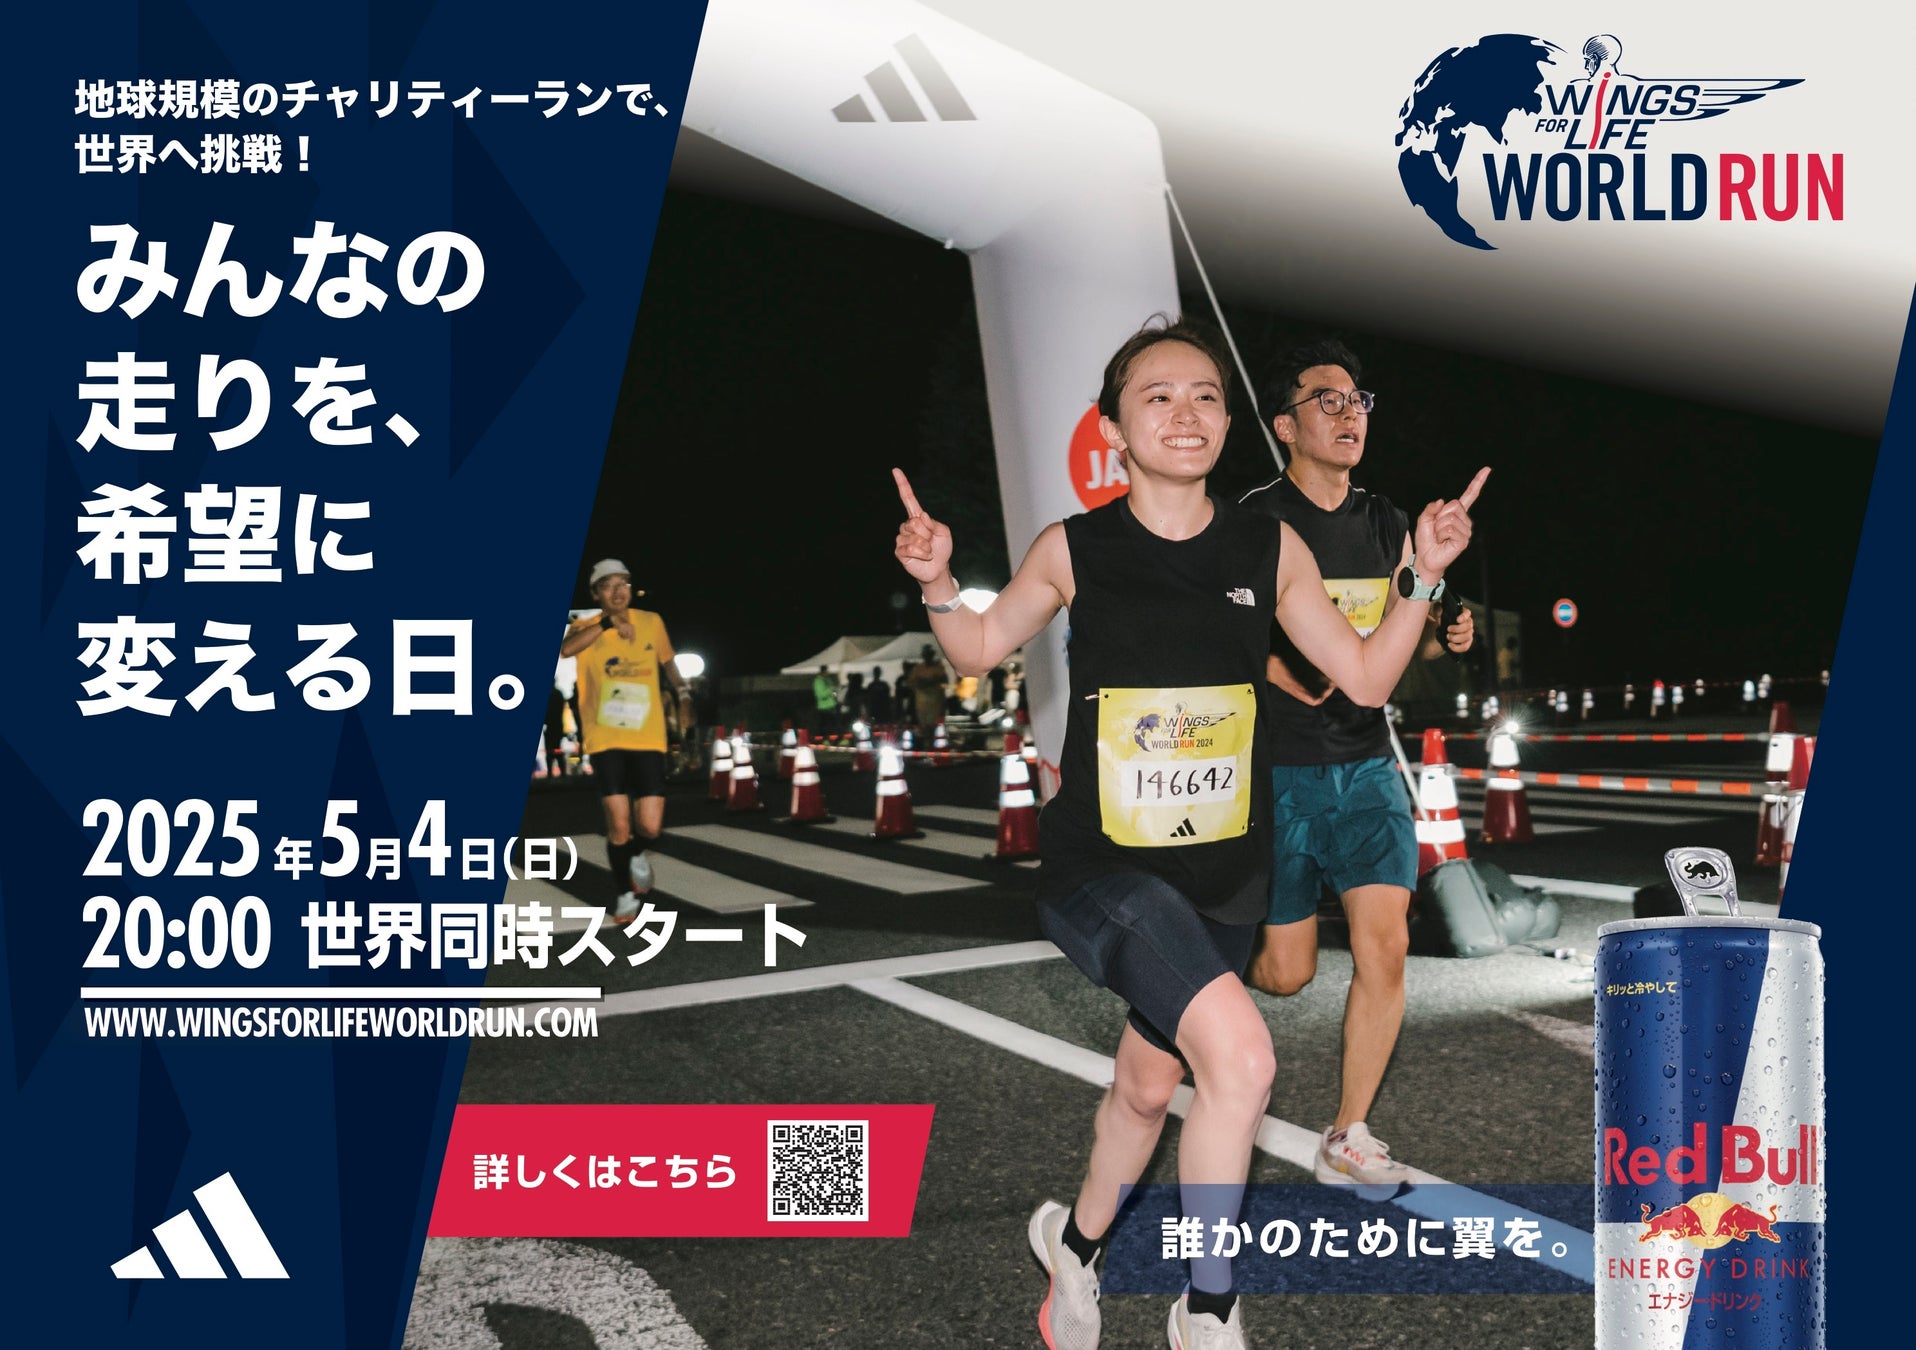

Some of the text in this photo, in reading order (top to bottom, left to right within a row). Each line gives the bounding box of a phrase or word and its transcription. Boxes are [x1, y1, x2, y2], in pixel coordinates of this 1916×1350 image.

[1170, 727, 1198, 738] LIFE
[1151, 738, 1214, 749] WORLD RUN 2024
[1136, 766, 1234, 800] 146642
[1606, 981, 1678, 997] キリッと冷やして
[1604, 1122, 1818, 1187] Red Bull
[1608, 1257, 1810, 1281] ENERGY DRINK
[1648, 1292, 1763, 1312] エナジードリンク
